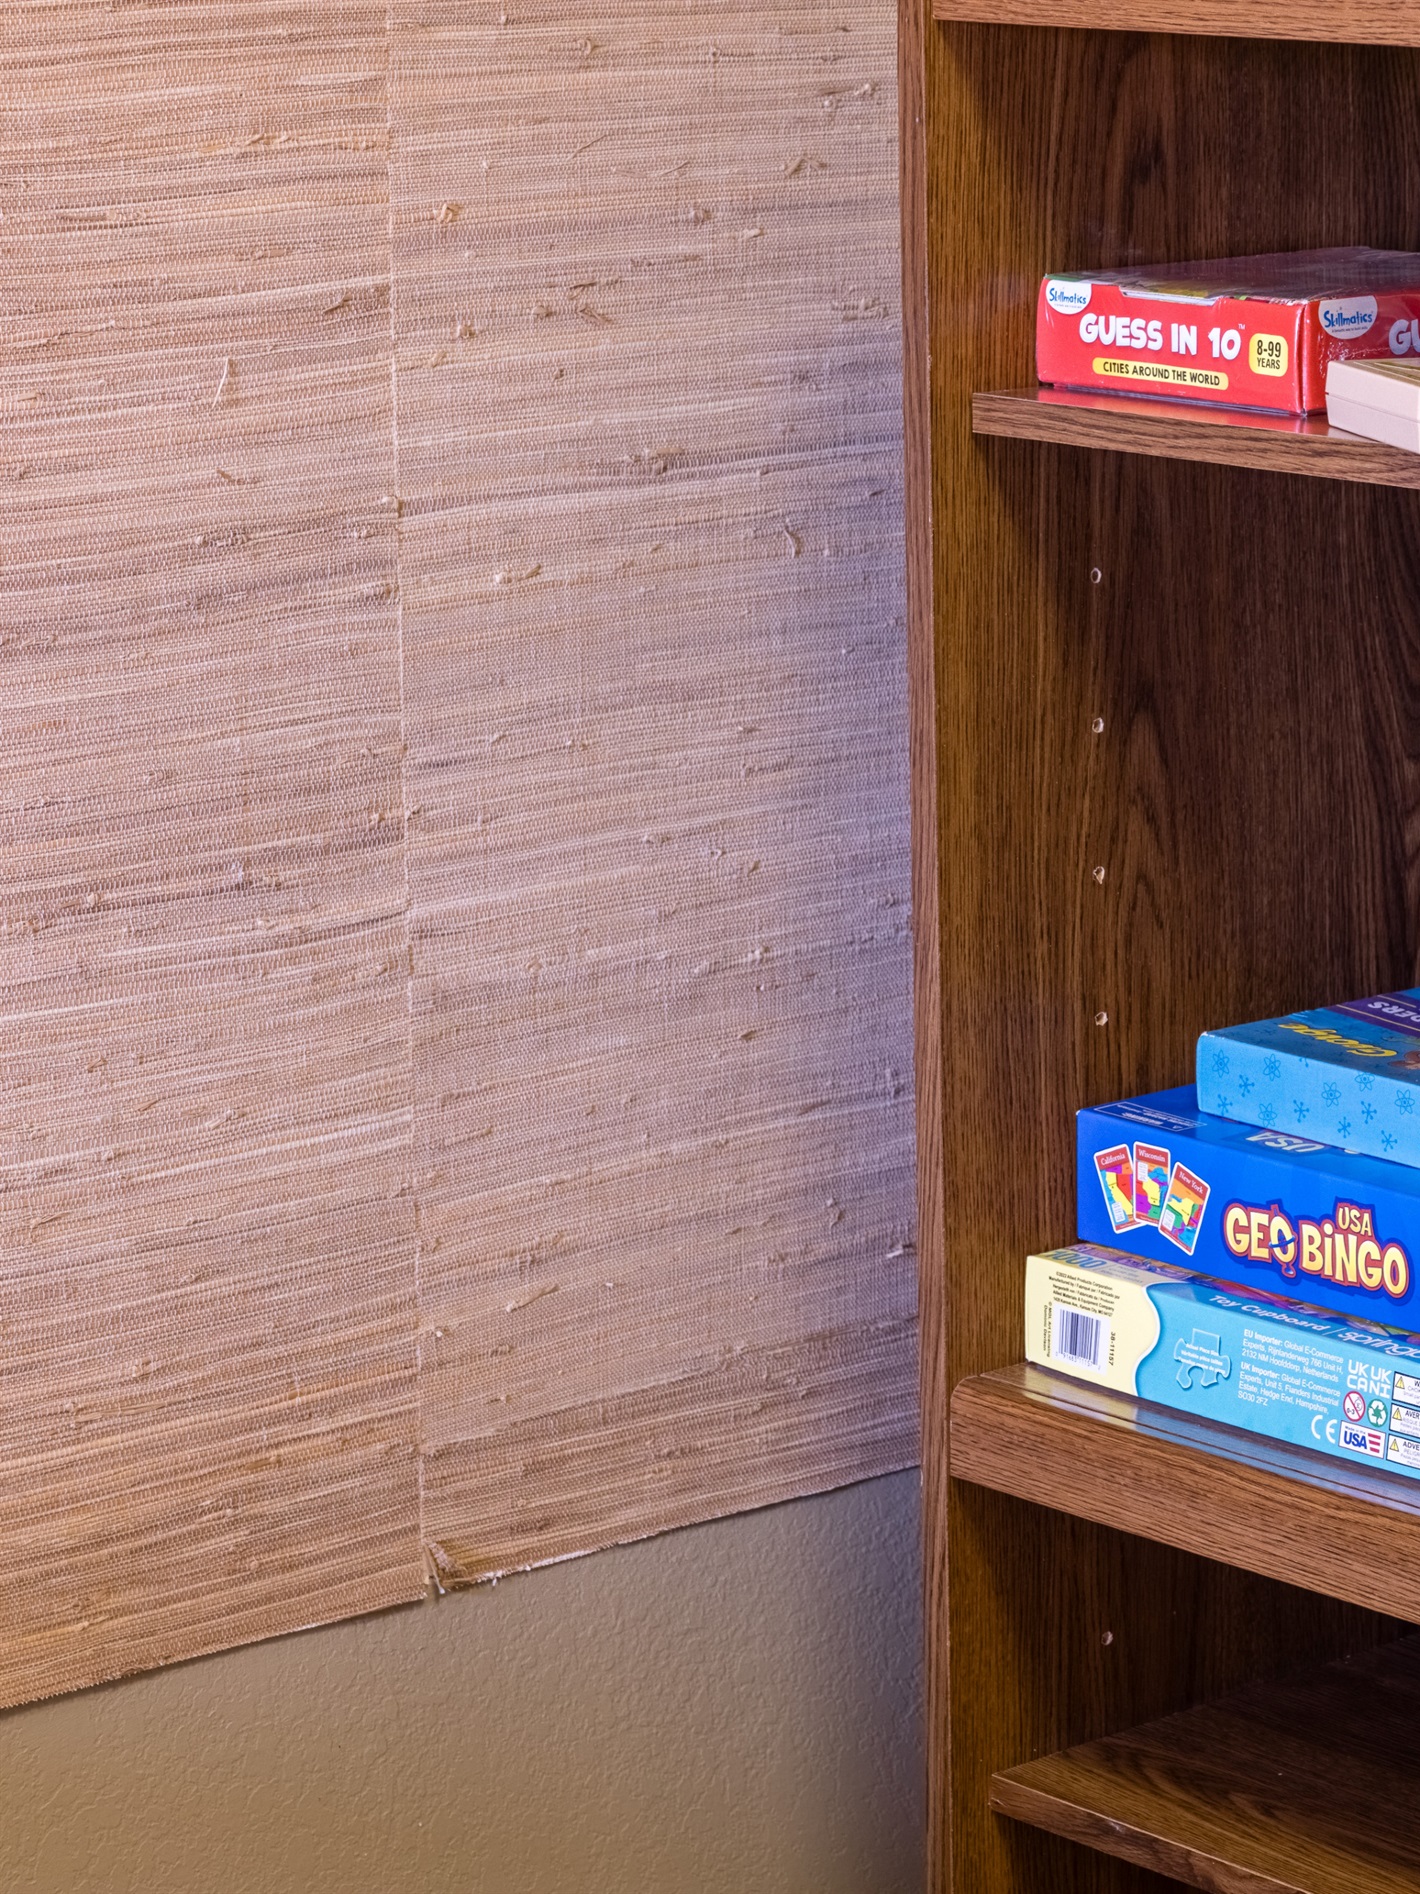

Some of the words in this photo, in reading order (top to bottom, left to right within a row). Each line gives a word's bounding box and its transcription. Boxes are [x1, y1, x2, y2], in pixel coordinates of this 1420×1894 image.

[1324, 309, 1373, 328] Skillmatics
[1079, 313, 1164, 351] GUESS
[1171, 323, 1198, 355] IN
[1208, 328, 1242, 360] 10
[1256, 340, 1282, 358] 8-99
[1103, 361, 1129, 375] CITIES
[1131, 364, 1170, 382] AROUND
[1172, 368, 1188, 382] THE
[1189, 370, 1220, 386] WORLD
[1257, 357, 1281, 370] YEARS
[1100, 1153, 1126, 1166] California
[1138, 1148, 1166, 1162] Wisconsin
[1179, 1171, 1193, 1186] New
[1191, 1180, 1204, 1194] York
[1226, 1207, 1296, 1263] GEO
[1338, 1206, 1372, 1236] USA
[1209, 1294, 1241, 1307] Toy
[1241, 1304, 1331, 1331] Cupboard
[1108, 1331, 1117, 1367] 38-11157
[1243, 1328, 1253, 1338] EU
[1254, 1332, 1282, 1346] Importer:
[1284, 1340, 1304, 1352] Global
[1304, 1346, 1344, 1363] E-Commerce
[1243, 1338, 1266, 1353] Experts,
[1323, 1361, 1336, 1372] Unit
[1336, 1365, 1343, 1375] H,
[1240, 1361, 1251, 1371] UK
[1252, 1364, 1280, 1379] Importer:
[1281, 1373, 1300, 1385] Global
[1301, 1379, 1341, 1397] E-Commerce
[1241, 1348, 1257, 1359] 2132
[1258, 1353, 1269, 1363] NM
[1303, 1365, 1339, 1382] Netherlands
[1239, 1371, 1263, 1386] Experts,
[1265, 1378, 1277, 1389] Unit
[1278, 1382, 1283, 1391] 5,
[1284, 1384, 1311, 1399] Flanders
[1311, 1391, 1339, 1407] Industrial
[1239, 1380, 1258, 1394] Estate,
[1260, 1387, 1280, 1401] Hedge
[1281, 1393, 1295, 1405] End,
[1295, 1397, 1329, 1415] Hampshire,
[1255, 1396, 1269, 1407] 2FZ
[1344, 1430, 1367, 1449] USA
